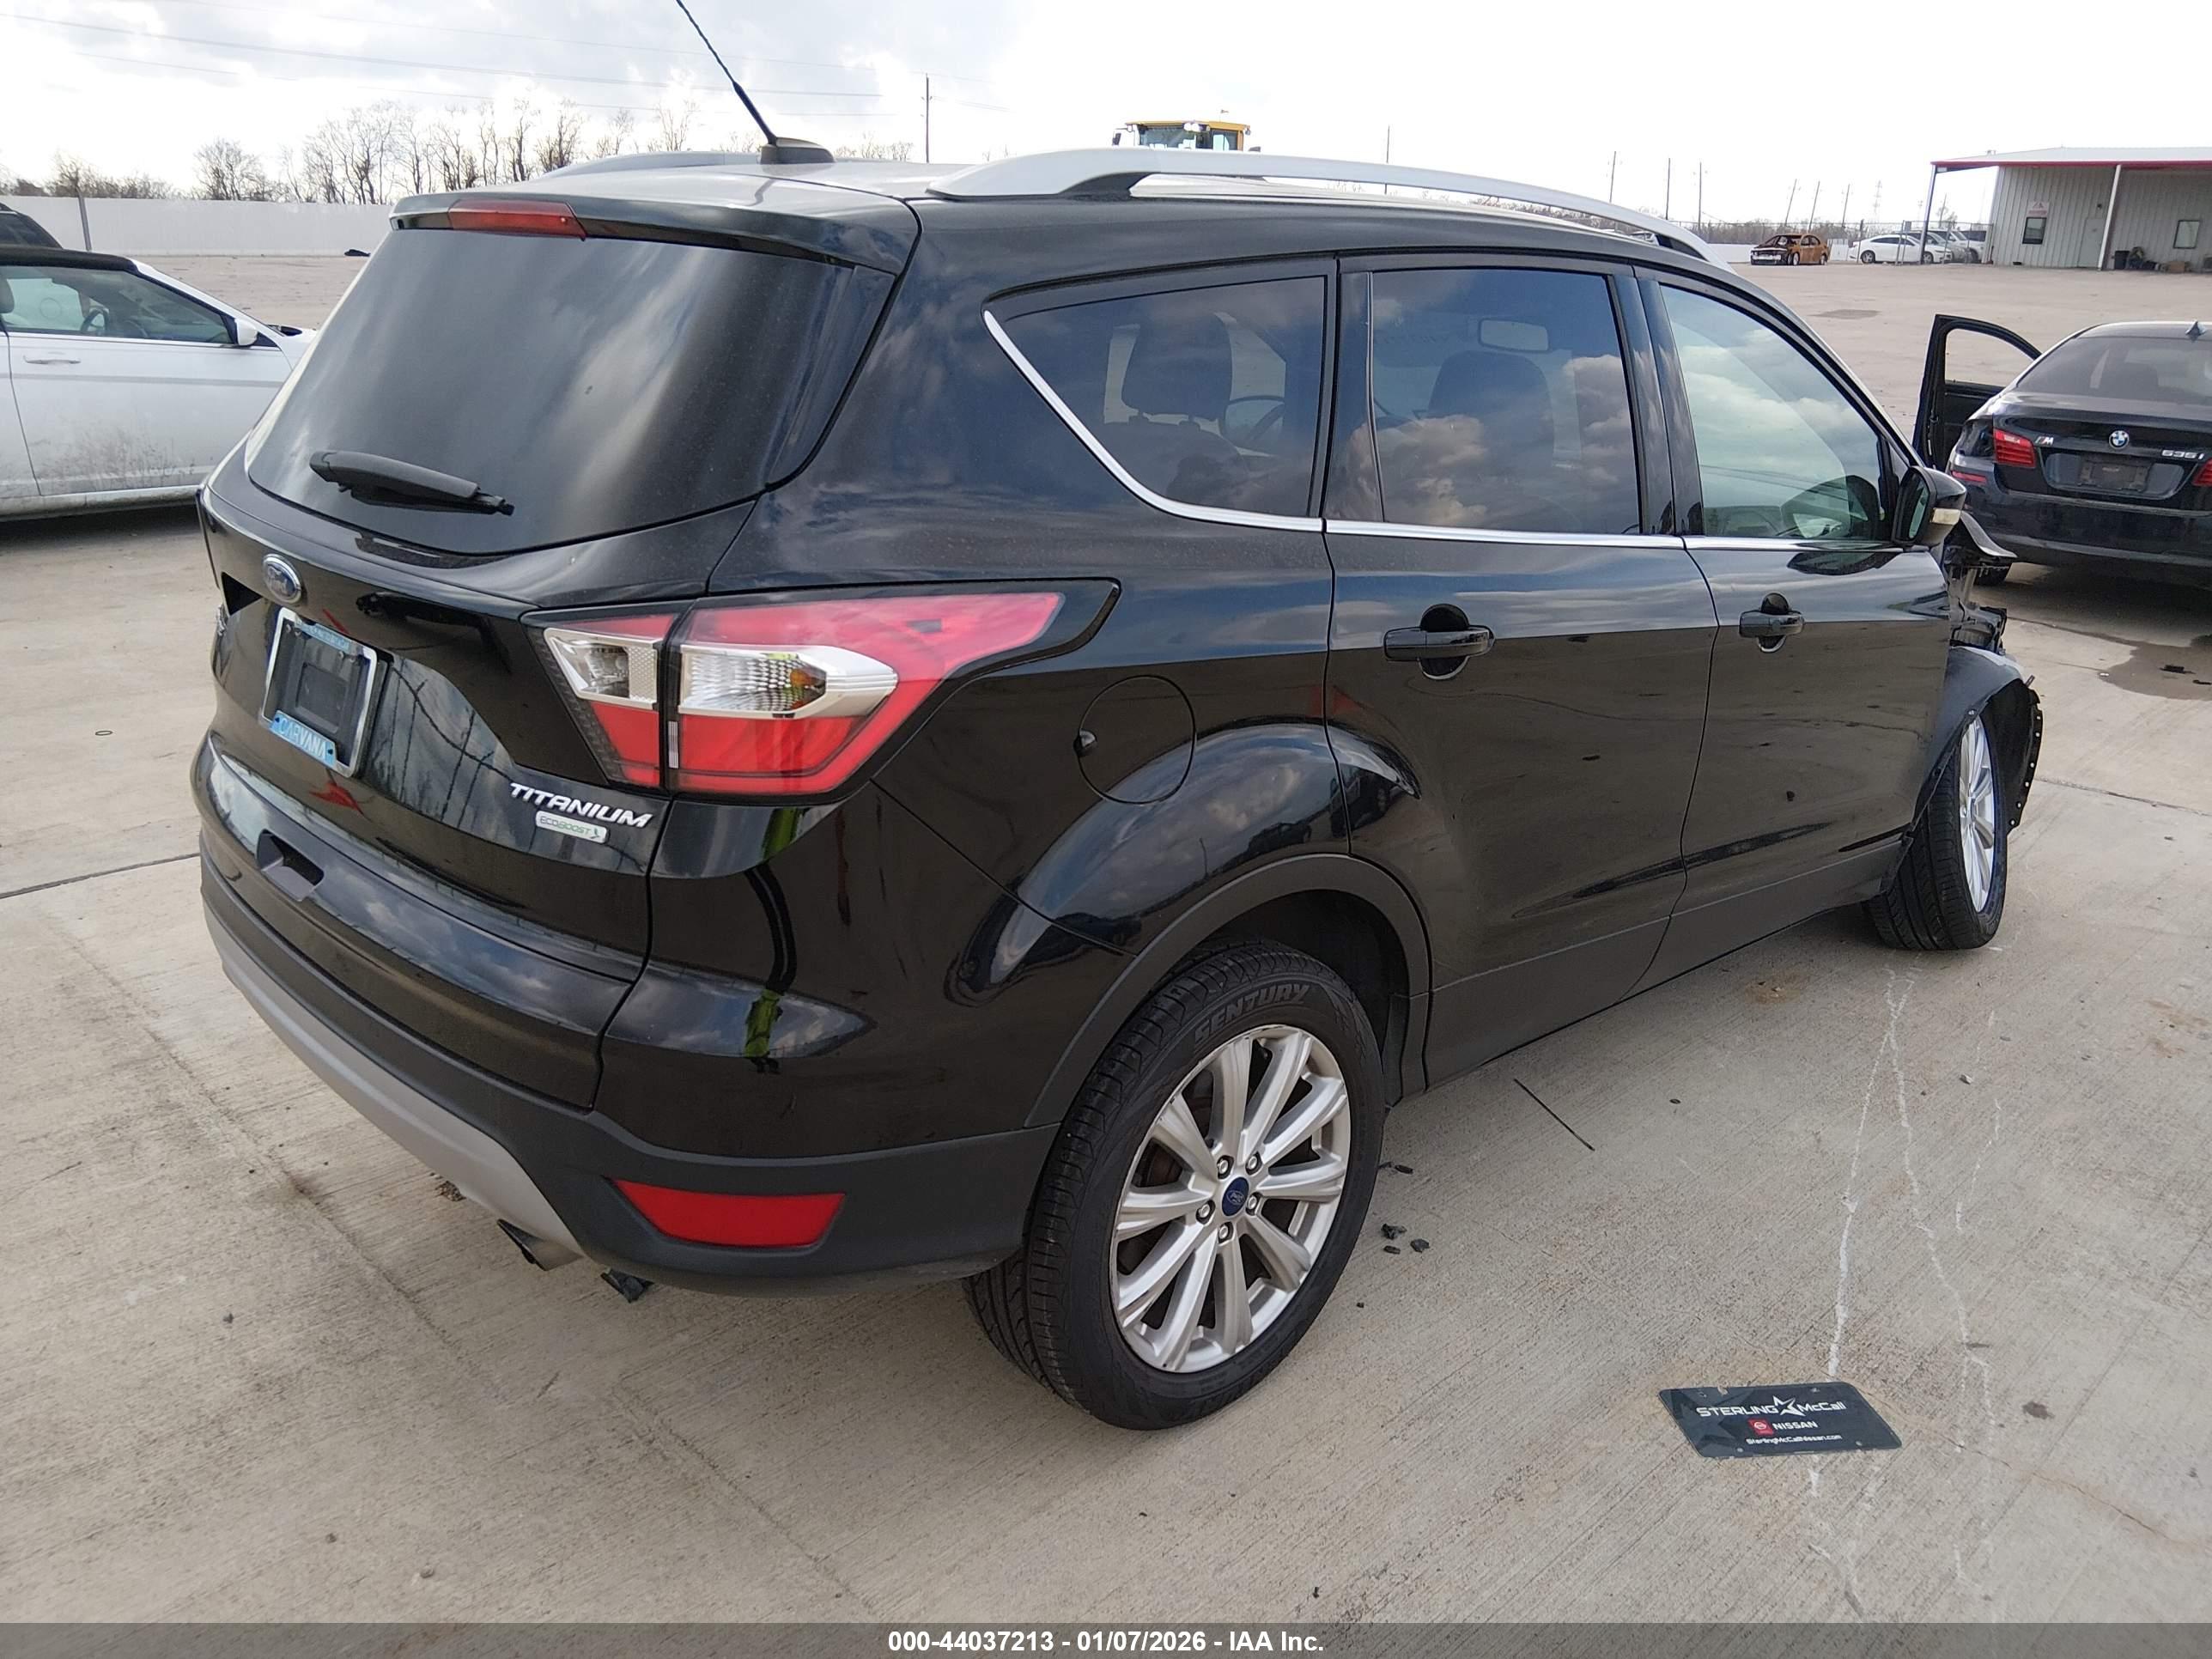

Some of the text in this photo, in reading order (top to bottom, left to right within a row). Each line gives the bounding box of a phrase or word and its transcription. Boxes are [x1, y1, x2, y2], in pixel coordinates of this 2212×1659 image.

[279, 718, 326, 760] CARVANA
[510, 782, 653, 828] TITANIUM
[1696, 1401, 1847, 1417] STERLING McCall
[1772, 1419, 1819, 1430] NISSAN
